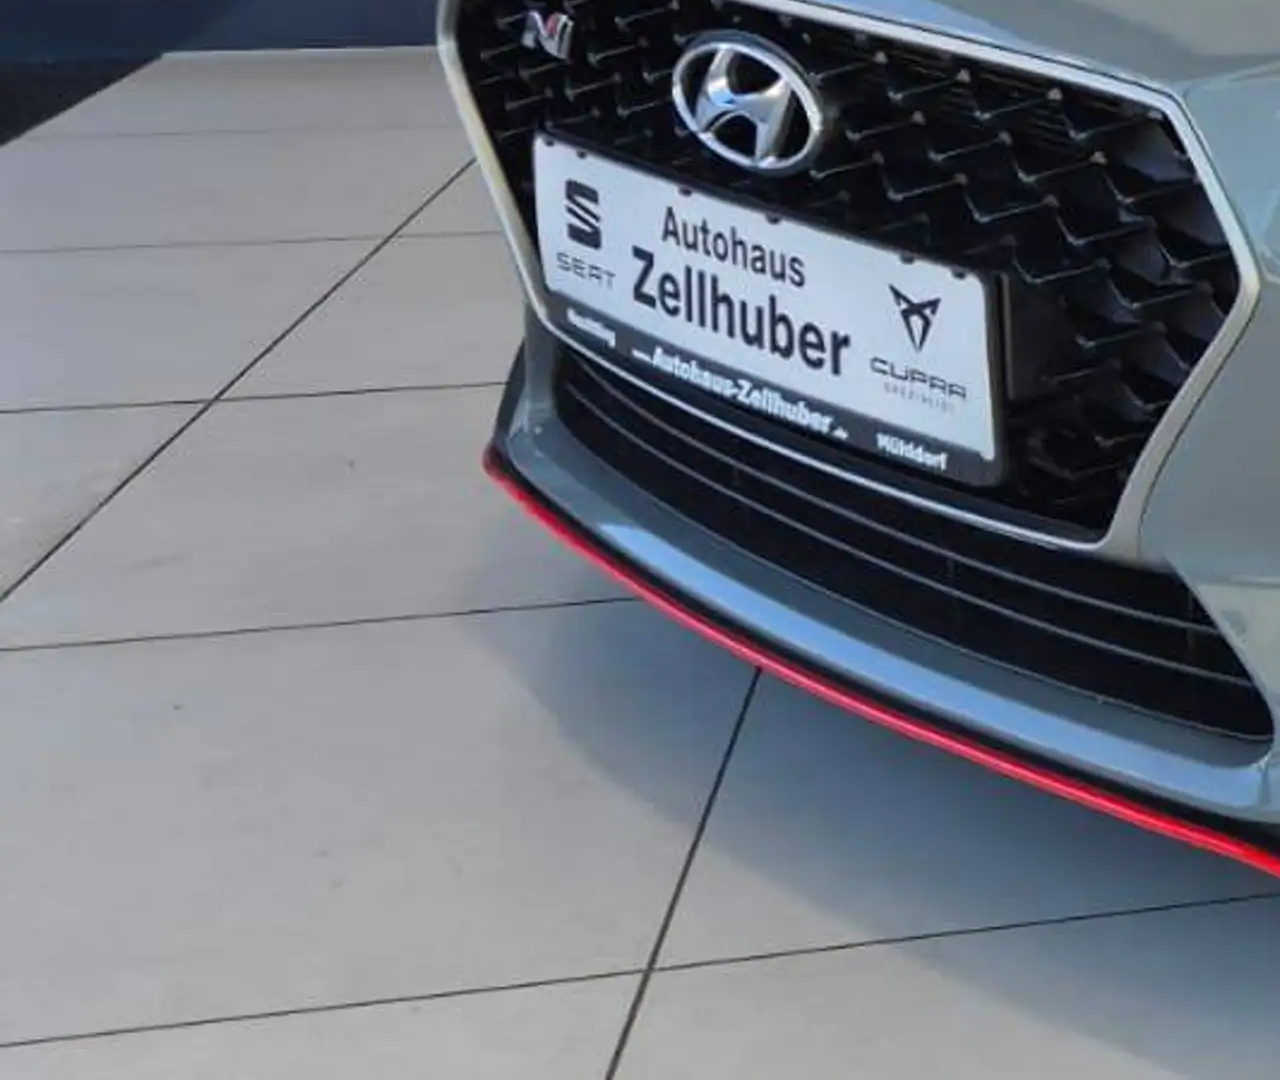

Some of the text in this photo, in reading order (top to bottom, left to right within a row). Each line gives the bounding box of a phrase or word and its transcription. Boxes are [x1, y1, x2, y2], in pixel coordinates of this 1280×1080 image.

[556, 251, 616, 289] SEAT
[661, 205, 806, 288] Autohaus
[631, 244, 852, 377] Zellhuber
[869, 356, 967, 400] CUPRA
